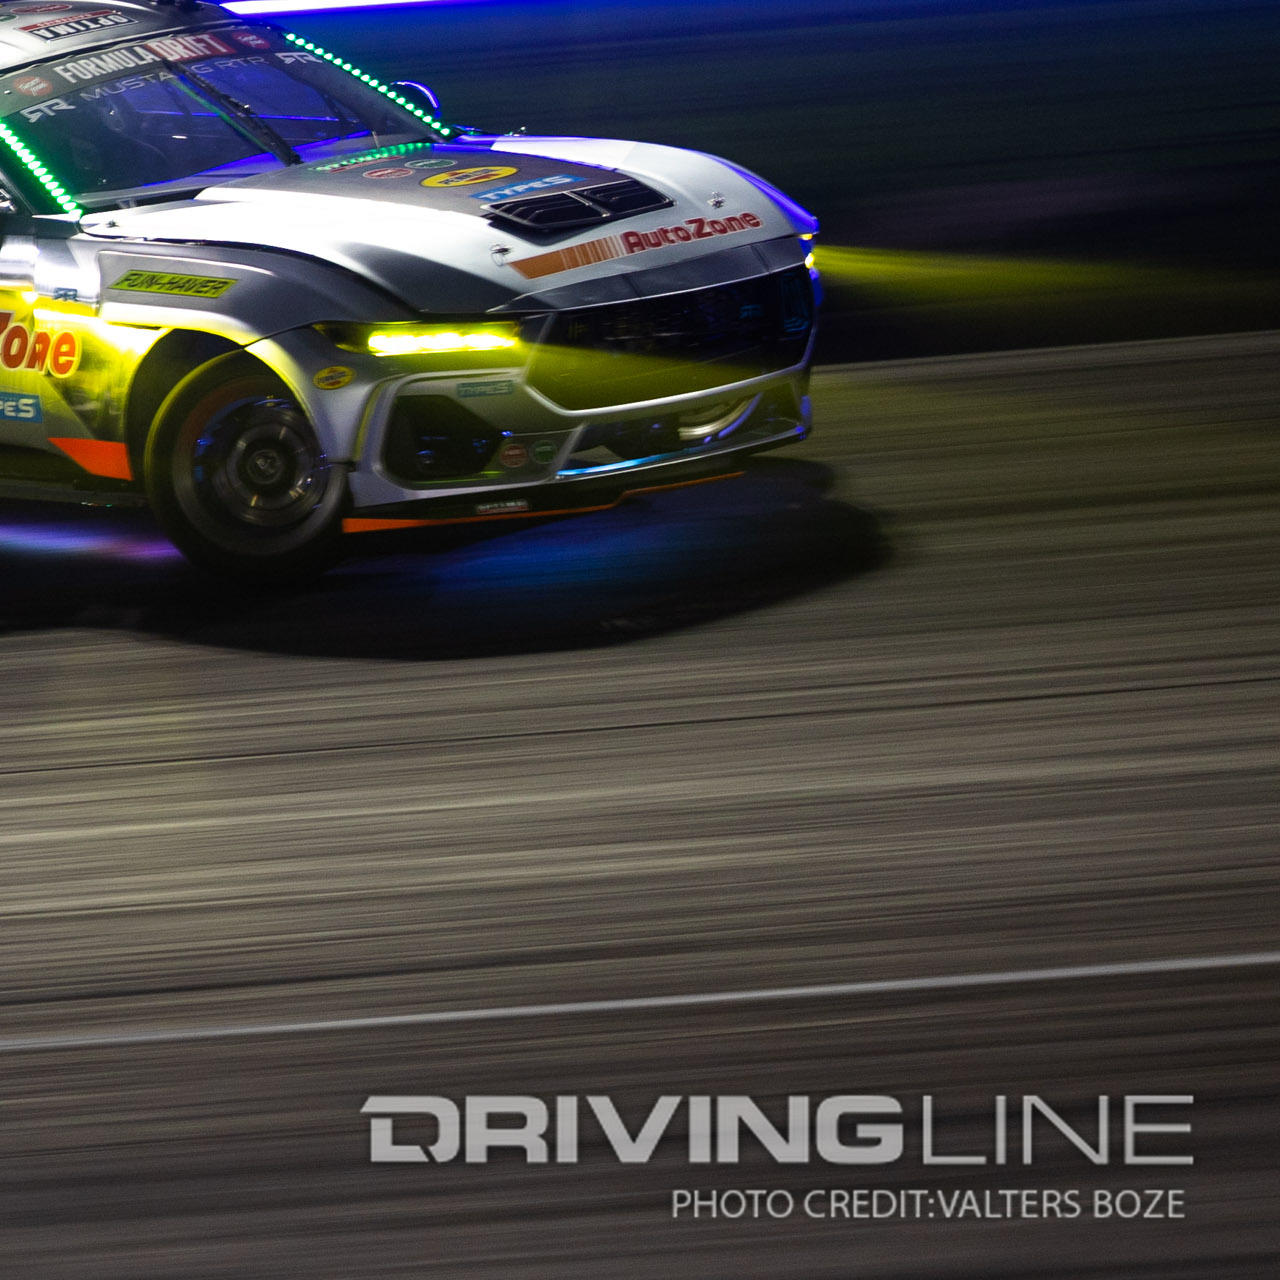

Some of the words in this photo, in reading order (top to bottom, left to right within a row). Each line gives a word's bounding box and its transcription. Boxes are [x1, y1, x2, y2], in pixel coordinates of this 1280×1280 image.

[33, 14, 130, 39] OPTIMA
[80, 65, 213, 101] MUSTAG
[621, 211, 762, 254] AutoZone
